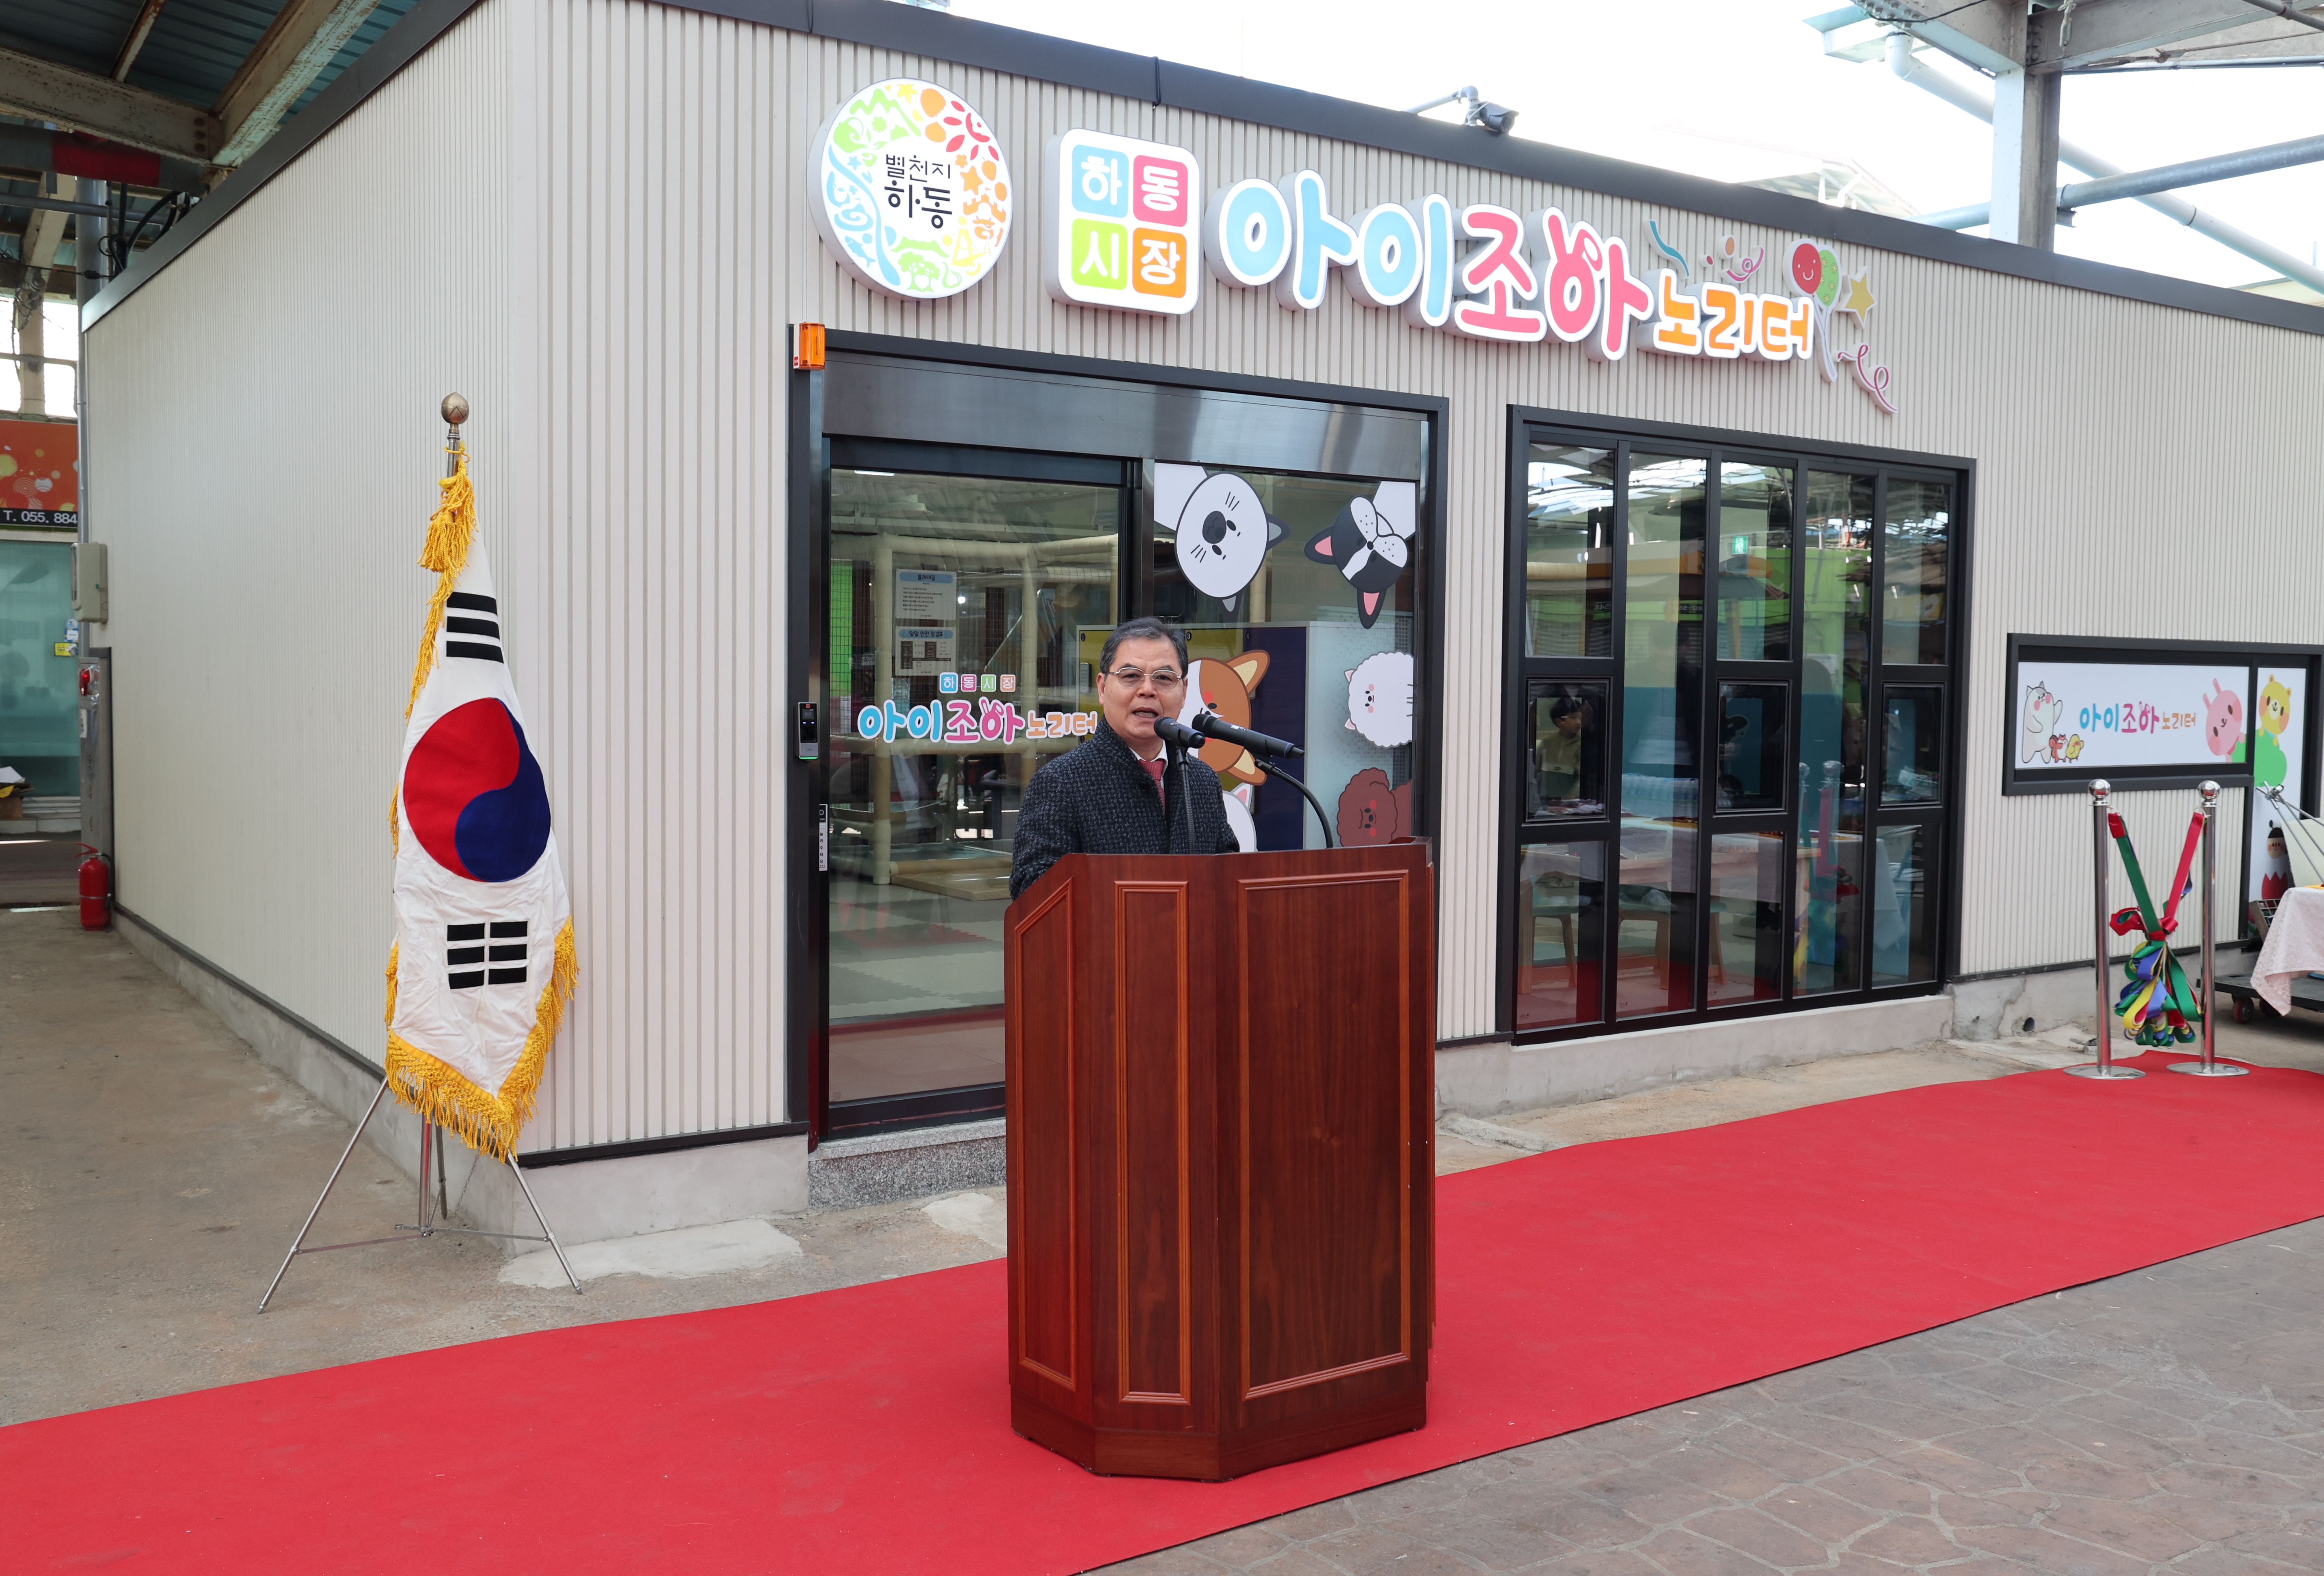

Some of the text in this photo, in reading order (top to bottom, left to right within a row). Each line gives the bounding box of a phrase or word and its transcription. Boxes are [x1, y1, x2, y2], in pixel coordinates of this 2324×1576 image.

[886, 154, 950, 183] 별천지
[1080, 155, 1181, 212] 하동
[884, 179, 952, 229] 하동
[1079, 230, 1181, 286] 시장
[1223, 173, 1810, 355] 아이조아 노리터
[3, 510, 17, 522] T.
[21, 511, 49, 523] 055.
[859, 698, 1096, 743] 아이조아 노리터
[2079, 701, 2196, 734] 아이조아 노리터
